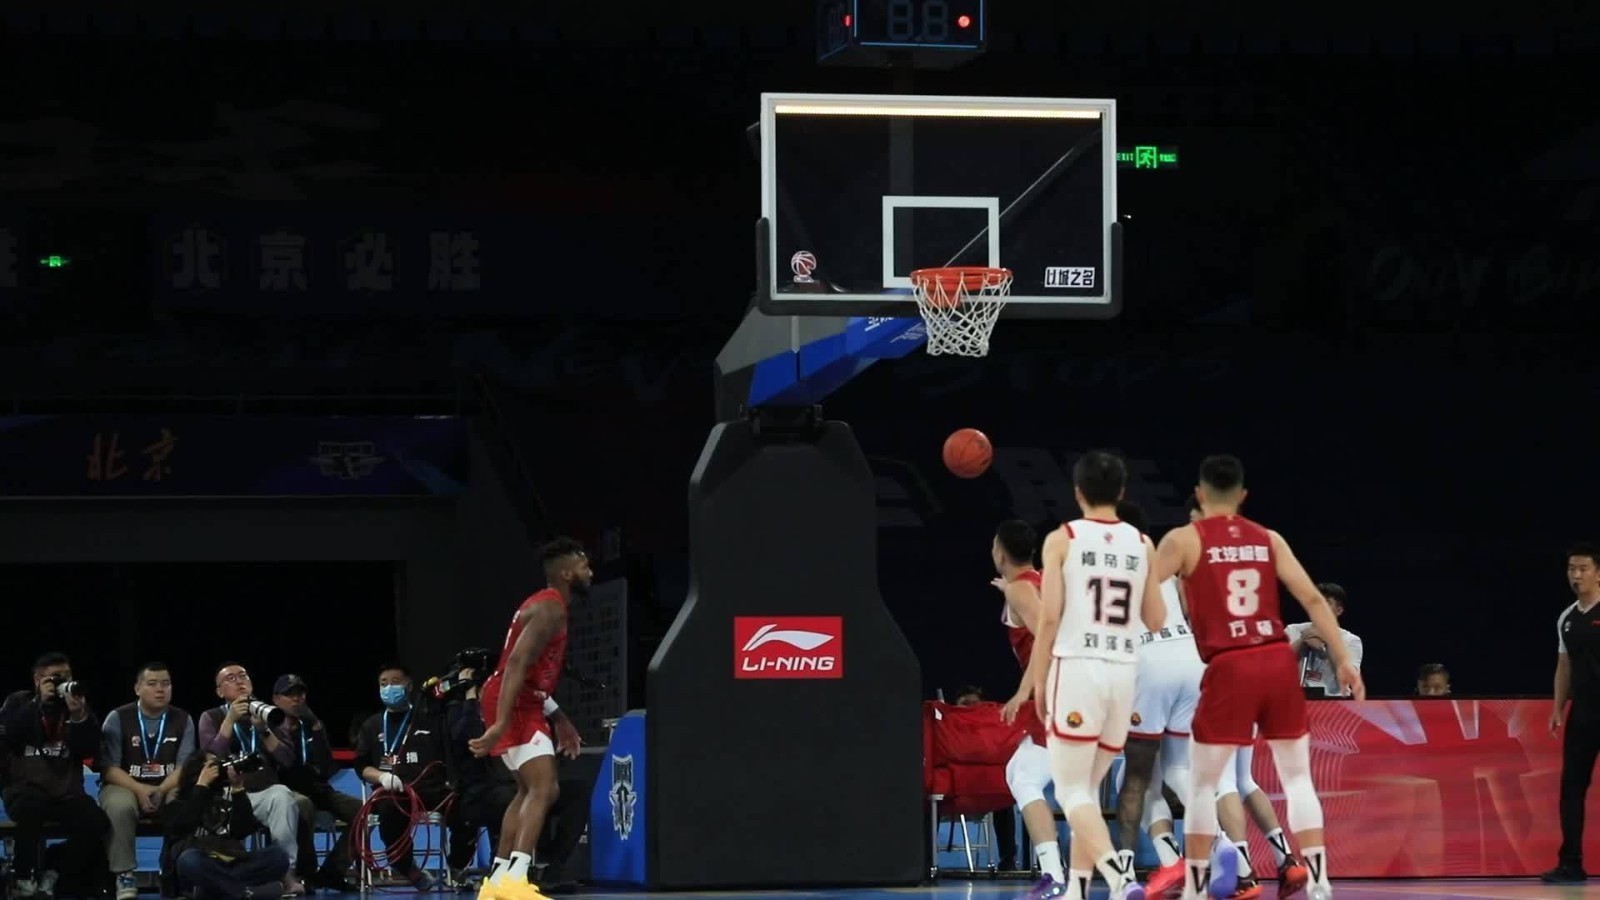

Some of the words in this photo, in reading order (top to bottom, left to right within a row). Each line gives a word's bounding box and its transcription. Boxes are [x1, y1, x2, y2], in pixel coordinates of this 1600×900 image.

[172, 228, 481, 291] 北京必胜
[1046, 268, 1093, 286] 以城之名
[85, 427, 180, 481] 北京
[1087, 577, 1132, 627] 13
[1227, 568, 1261, 617] 8
[742, 656, 835, 671] LI-NING
